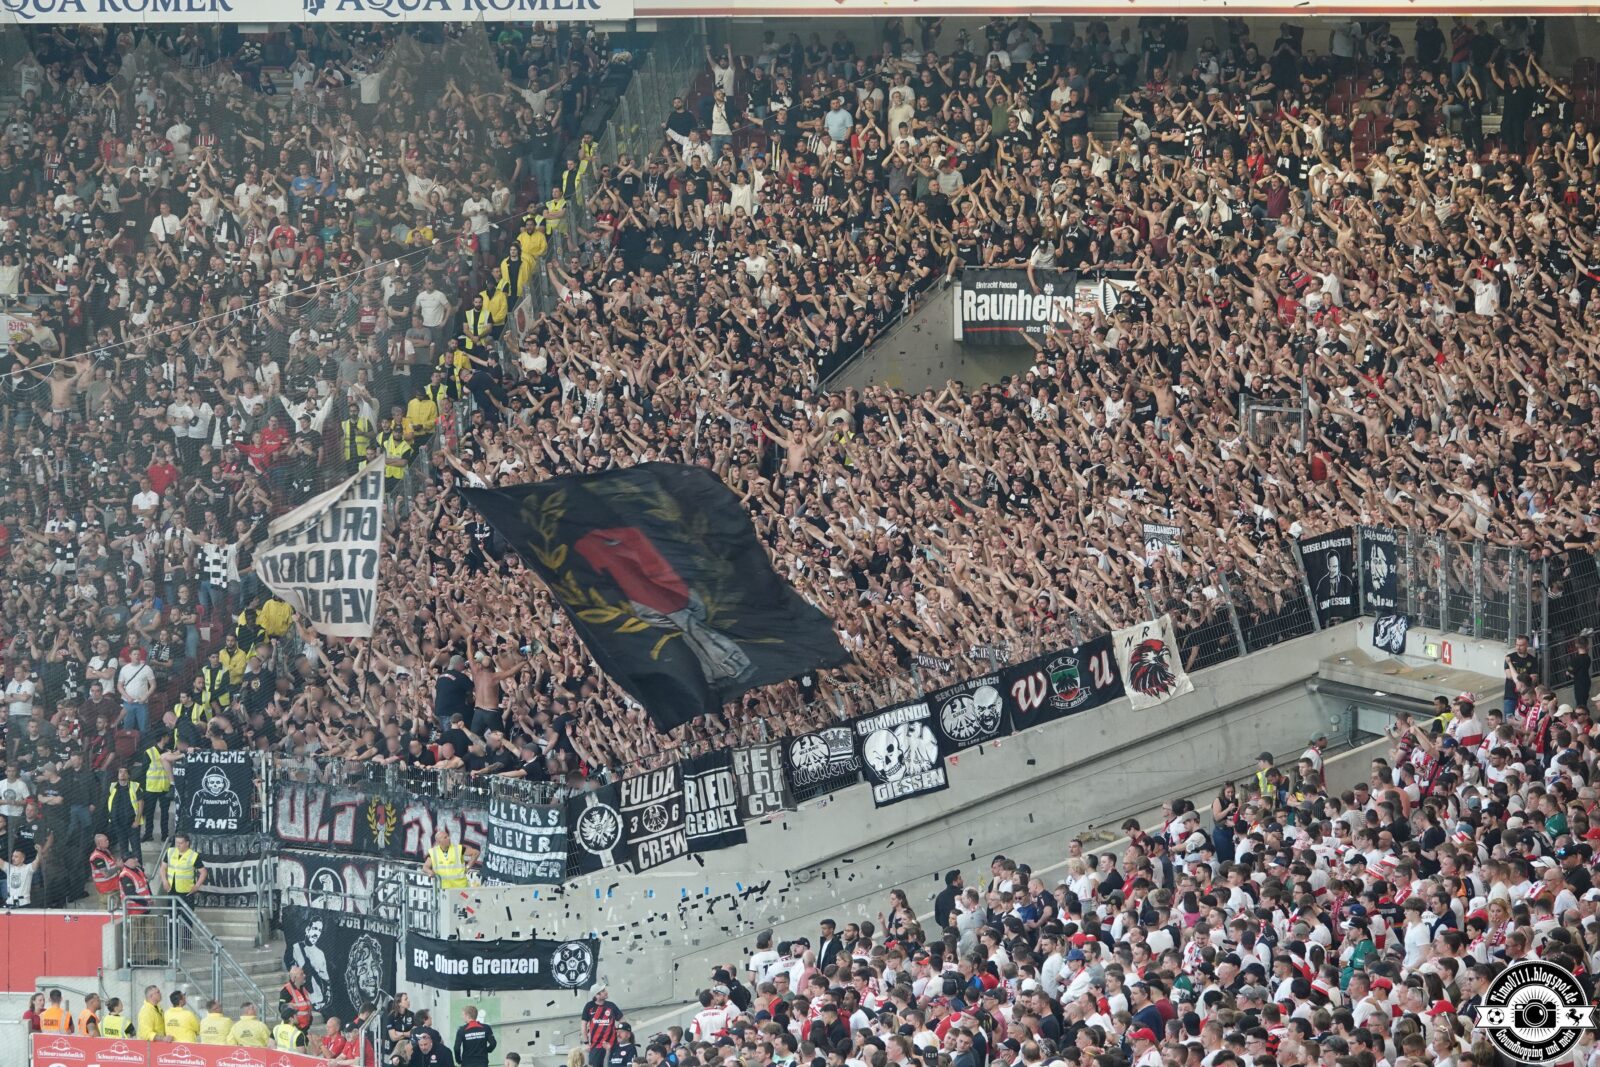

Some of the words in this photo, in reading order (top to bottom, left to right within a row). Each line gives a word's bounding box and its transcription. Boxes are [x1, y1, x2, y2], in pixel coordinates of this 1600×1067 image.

[963, 289, 1074, 323] Raunheim
[1025, 325, 1040, 333] since
[1443, 644, 1450, 663] 4
[856, 702, 931, 736] COMMANDO
[187, 751, 245, 764] EXTREME
[620, 765, 675, 807] FULDA
[684, 771, 736, 813] RIED
[873, 767, 945, 802] GIESSEN
[748, 791, 782, 816] 64
[194, 818, 238, 830] FANS
[630, 818, 638, 834] 3
[671, 803, 679, 821] 6
[685, 805, 738, 836] GEBIET
[493, 826, 551, 852] NEVER
[637, 829, 688, 870] CREW
[338, 916, 361, 929] FÜR
[414, 948, 429, 968] EFC
[434, 956, 468, 975] Ohne
[472, 956, 539, 975] Grenzen
